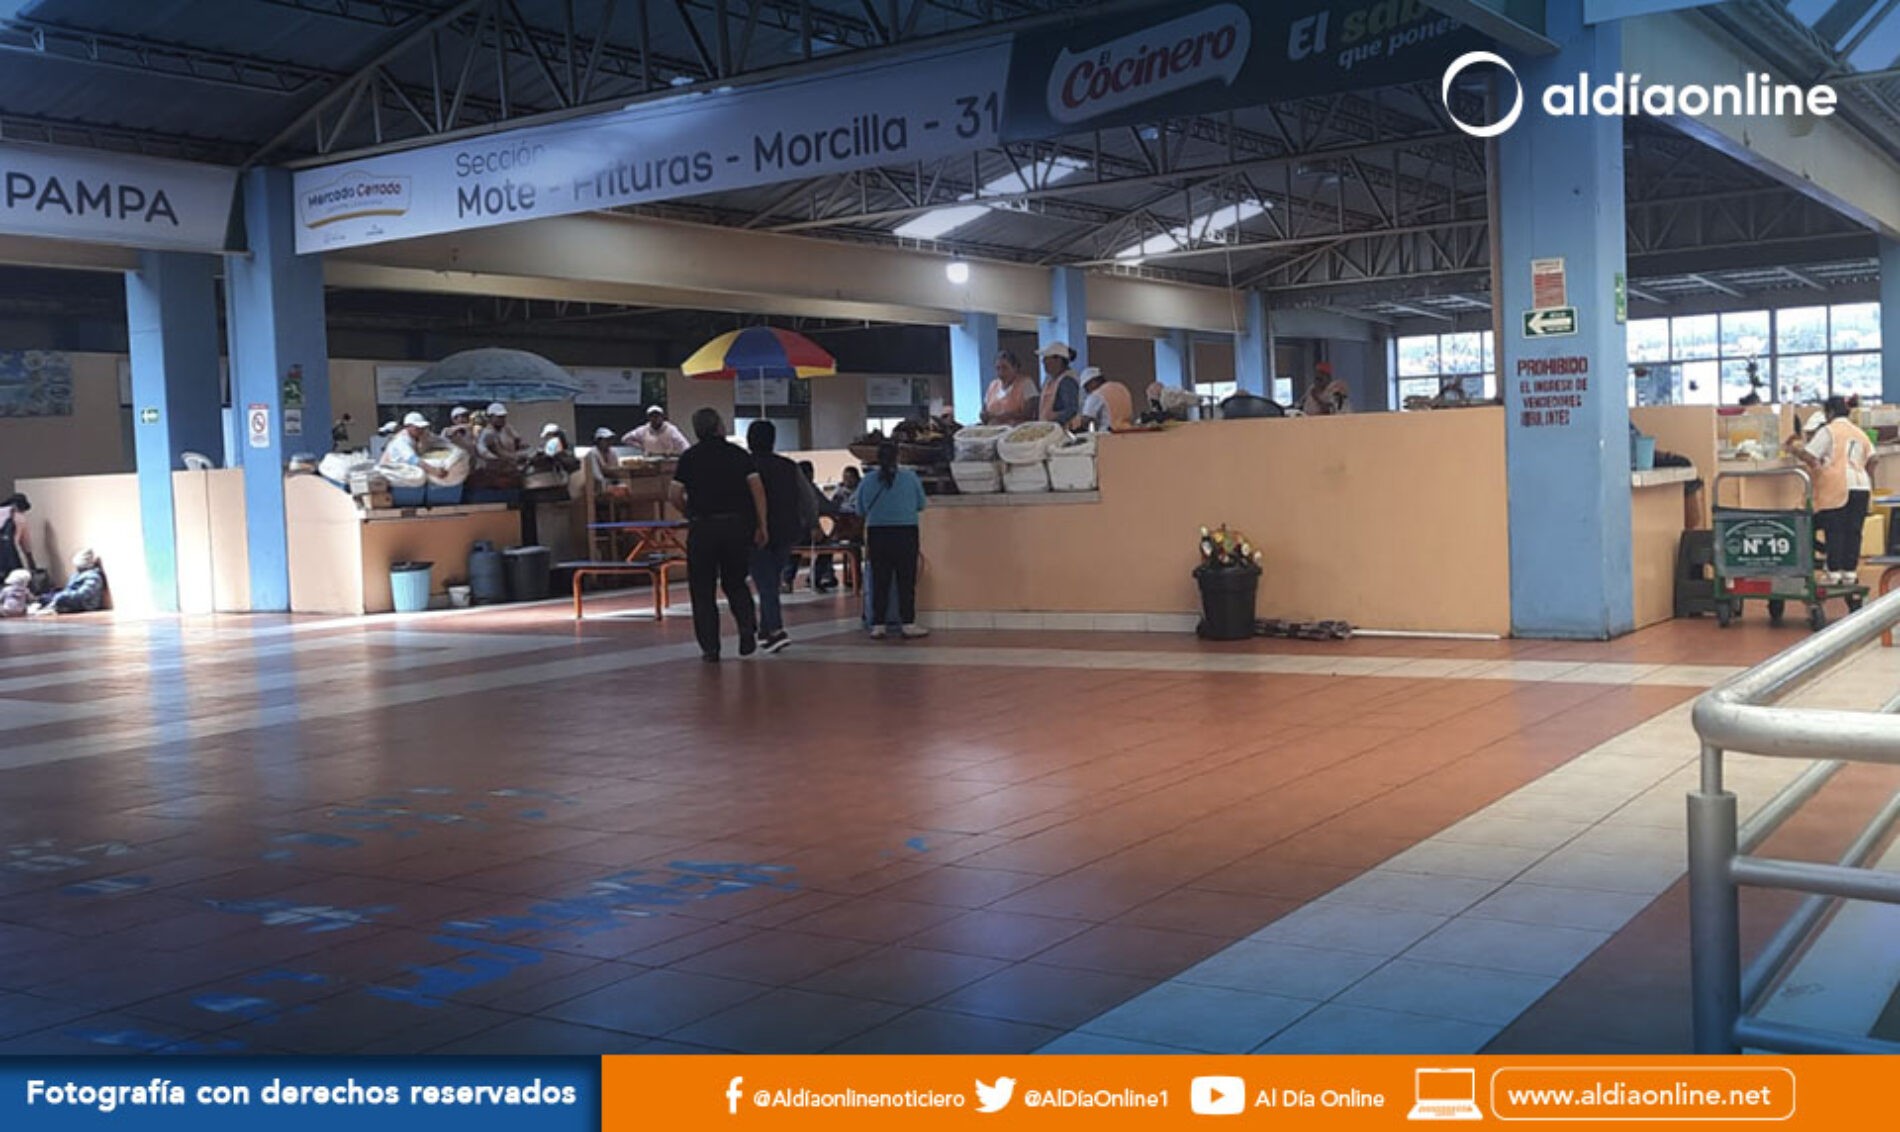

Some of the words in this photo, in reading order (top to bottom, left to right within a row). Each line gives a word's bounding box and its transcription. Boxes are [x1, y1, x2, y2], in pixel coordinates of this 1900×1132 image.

[1288, 10, 1330, 61] El
[1338, 39, 1382, 70] que
[1061, 24, 1236, 108] Cocinero
[456, 140, 545, 177] Sección
[458, 178, 536, 219] Mote
[573, 151, 714, 201] Frituras
[754, 113, 908, 172] Morcilla
[924, 120, 939, 130] -
[956, 91, 998, 139] 31
[6, 171, 179, 227] PAMPA
[1517, 356, 1588, 376] PROHIBIDO
[1767, 538, 1790, 554] 19
